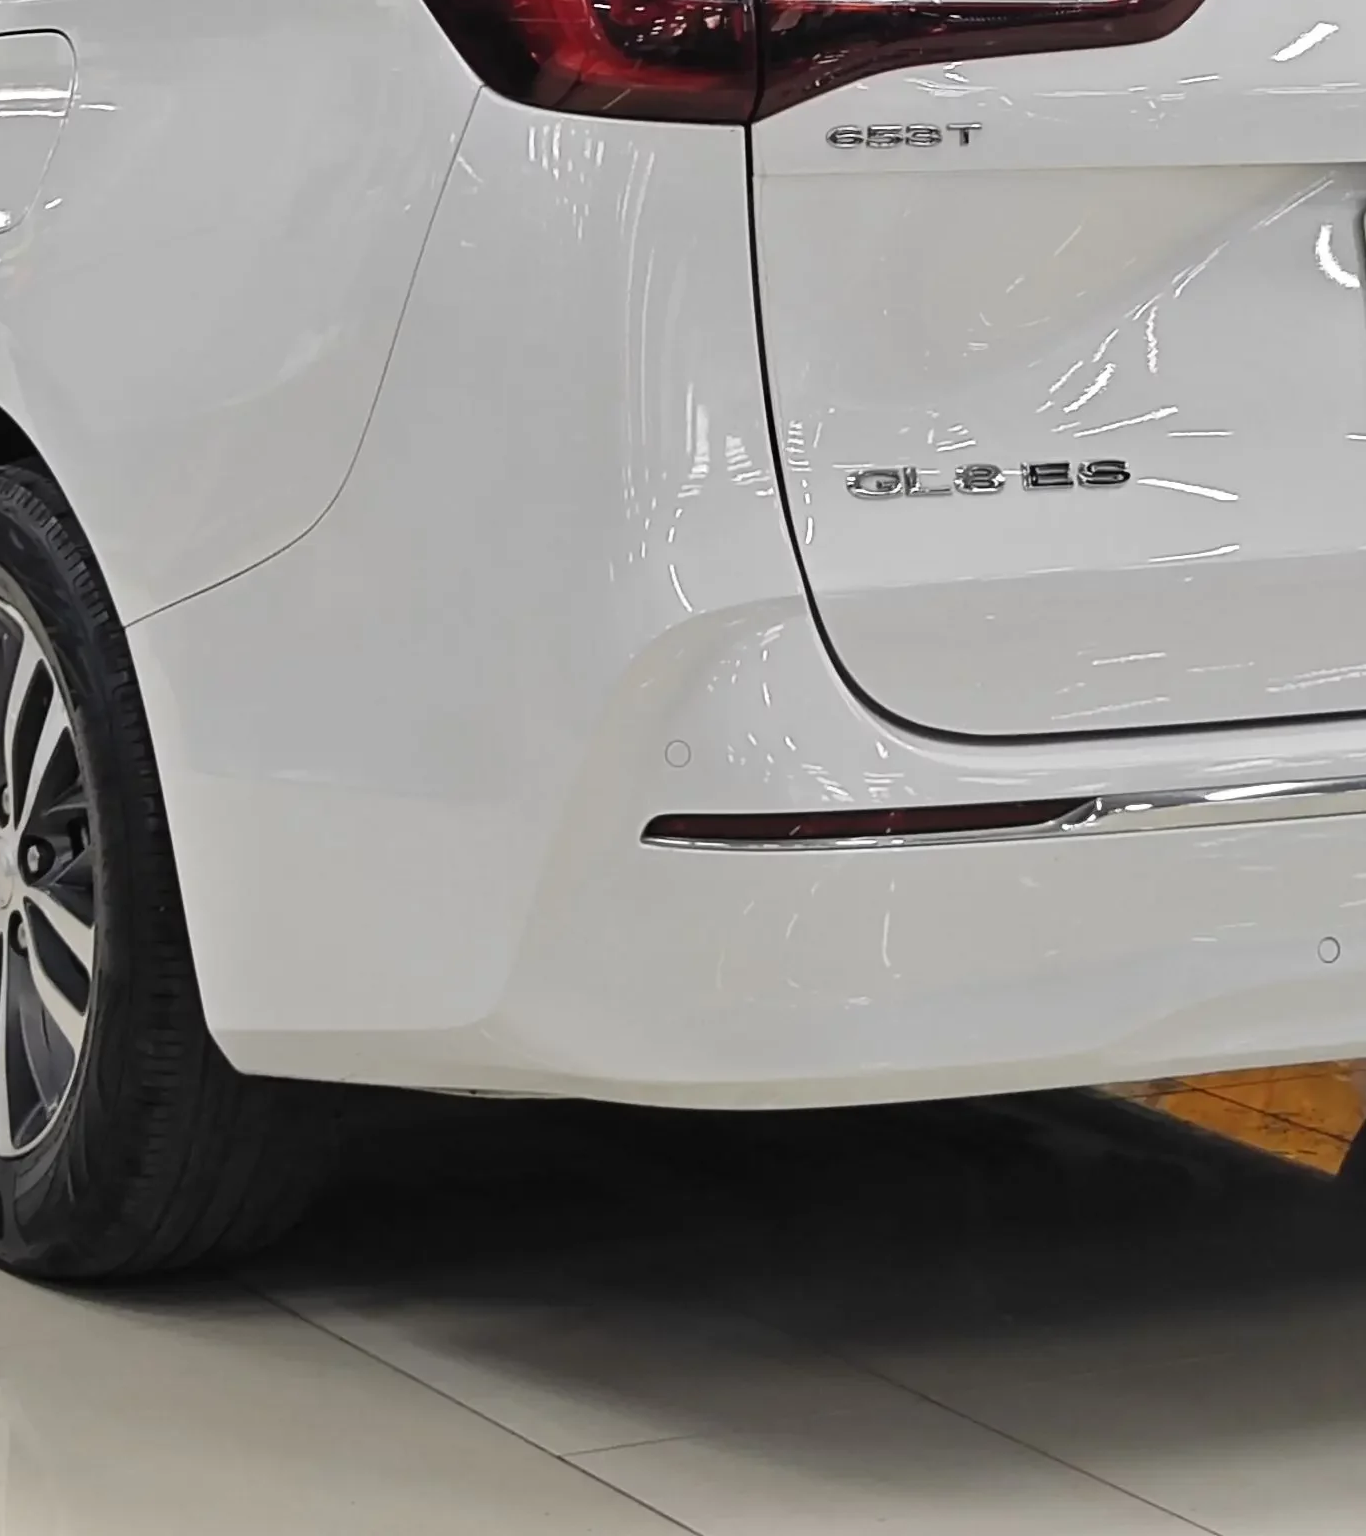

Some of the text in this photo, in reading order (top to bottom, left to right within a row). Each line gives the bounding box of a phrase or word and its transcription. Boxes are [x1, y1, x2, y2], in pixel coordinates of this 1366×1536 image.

[825, 122, 983, 149] 653T
[845, 460, 1132, 500] GL8 ES
